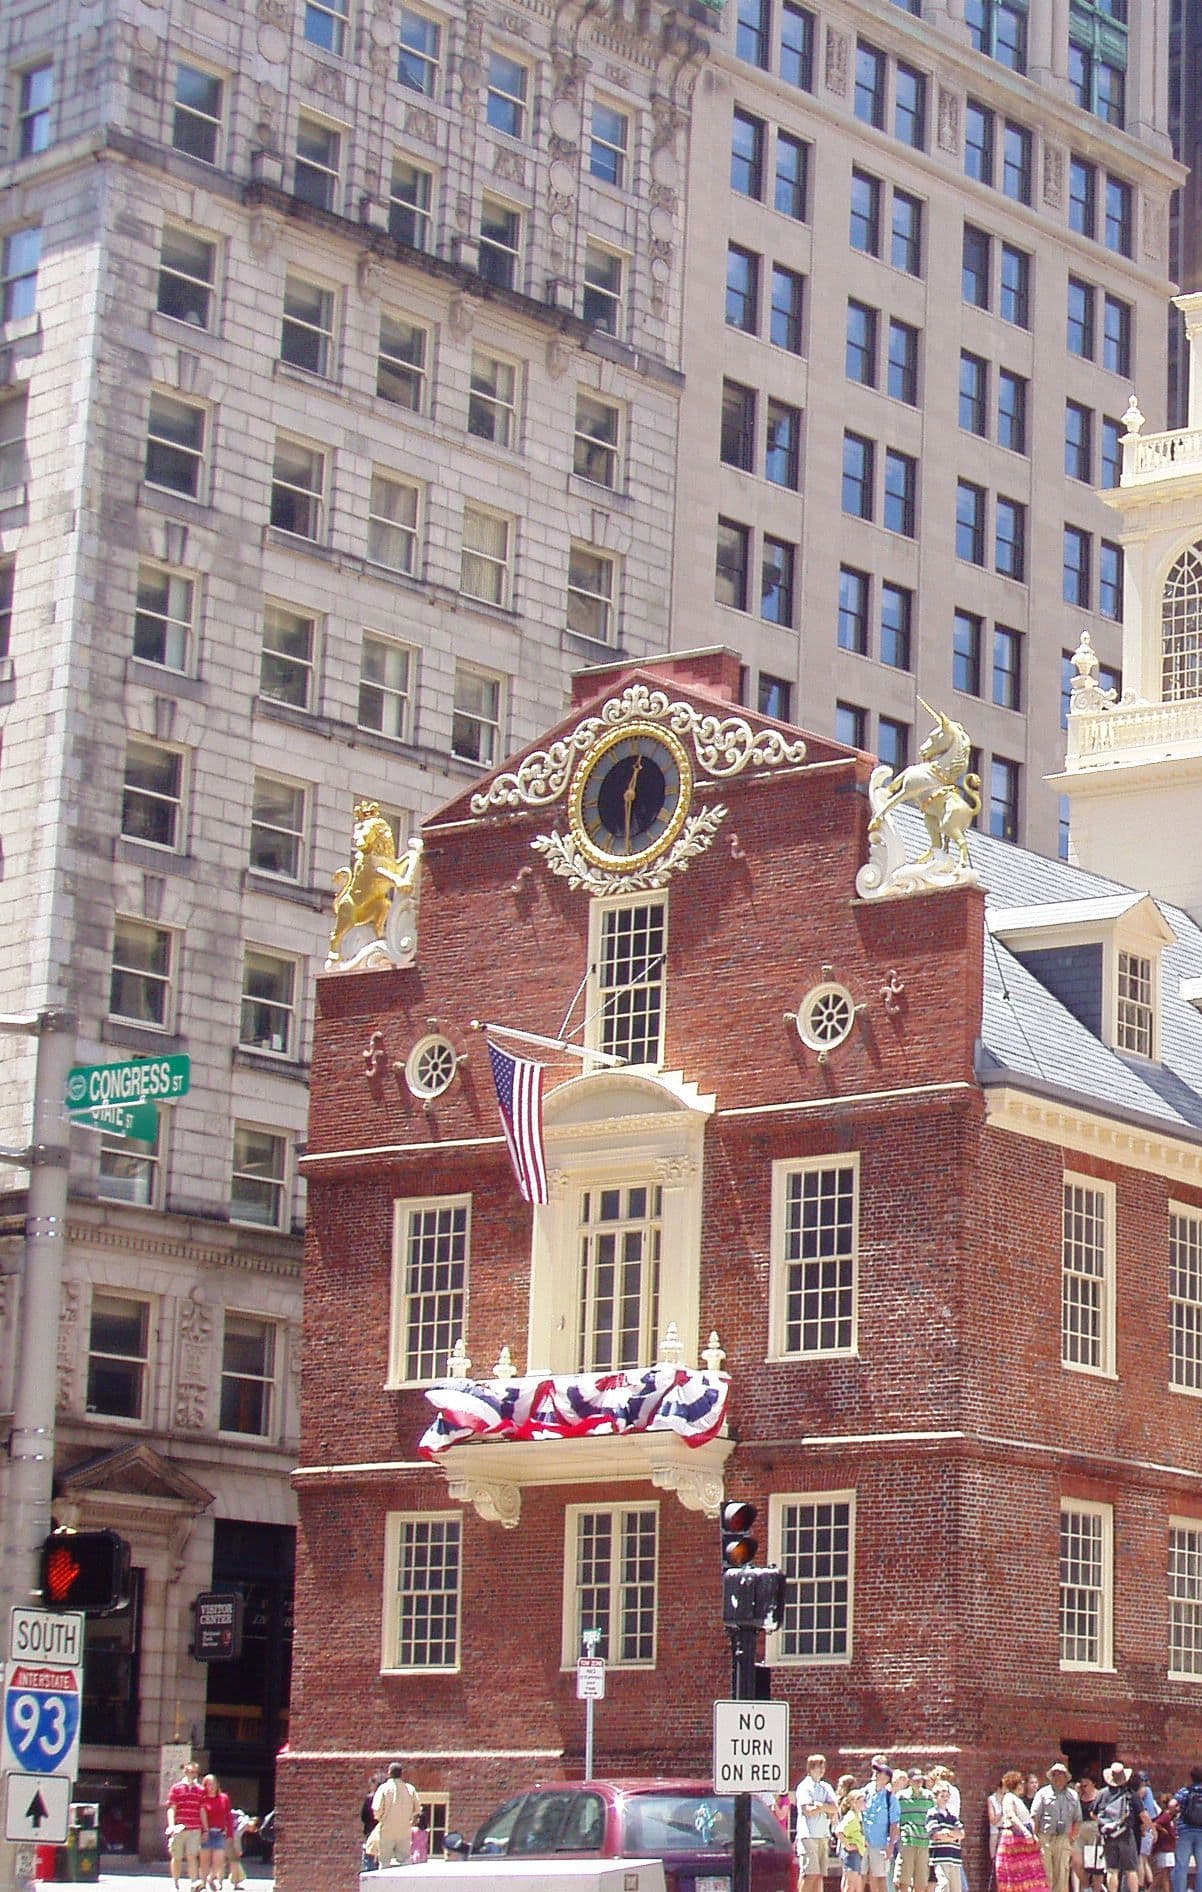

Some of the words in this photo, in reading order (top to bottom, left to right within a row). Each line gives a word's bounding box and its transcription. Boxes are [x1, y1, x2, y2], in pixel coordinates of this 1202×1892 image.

[89, 1062, 170, 1101] CONGRESS
[172, 1075, 184, 1092] ST
[18, 1620, 76, 1654] SOUTH
[18, 1671, 70, 1690] INTERSTATE
[14, 1694, 66, 1756] 93
[739, 1713, 765, 1730] NO
[730, 1739, 772, 1756] TURN
[721, 1763, 743, 1781] ON
[751, 1764, 781, 1781] RED
